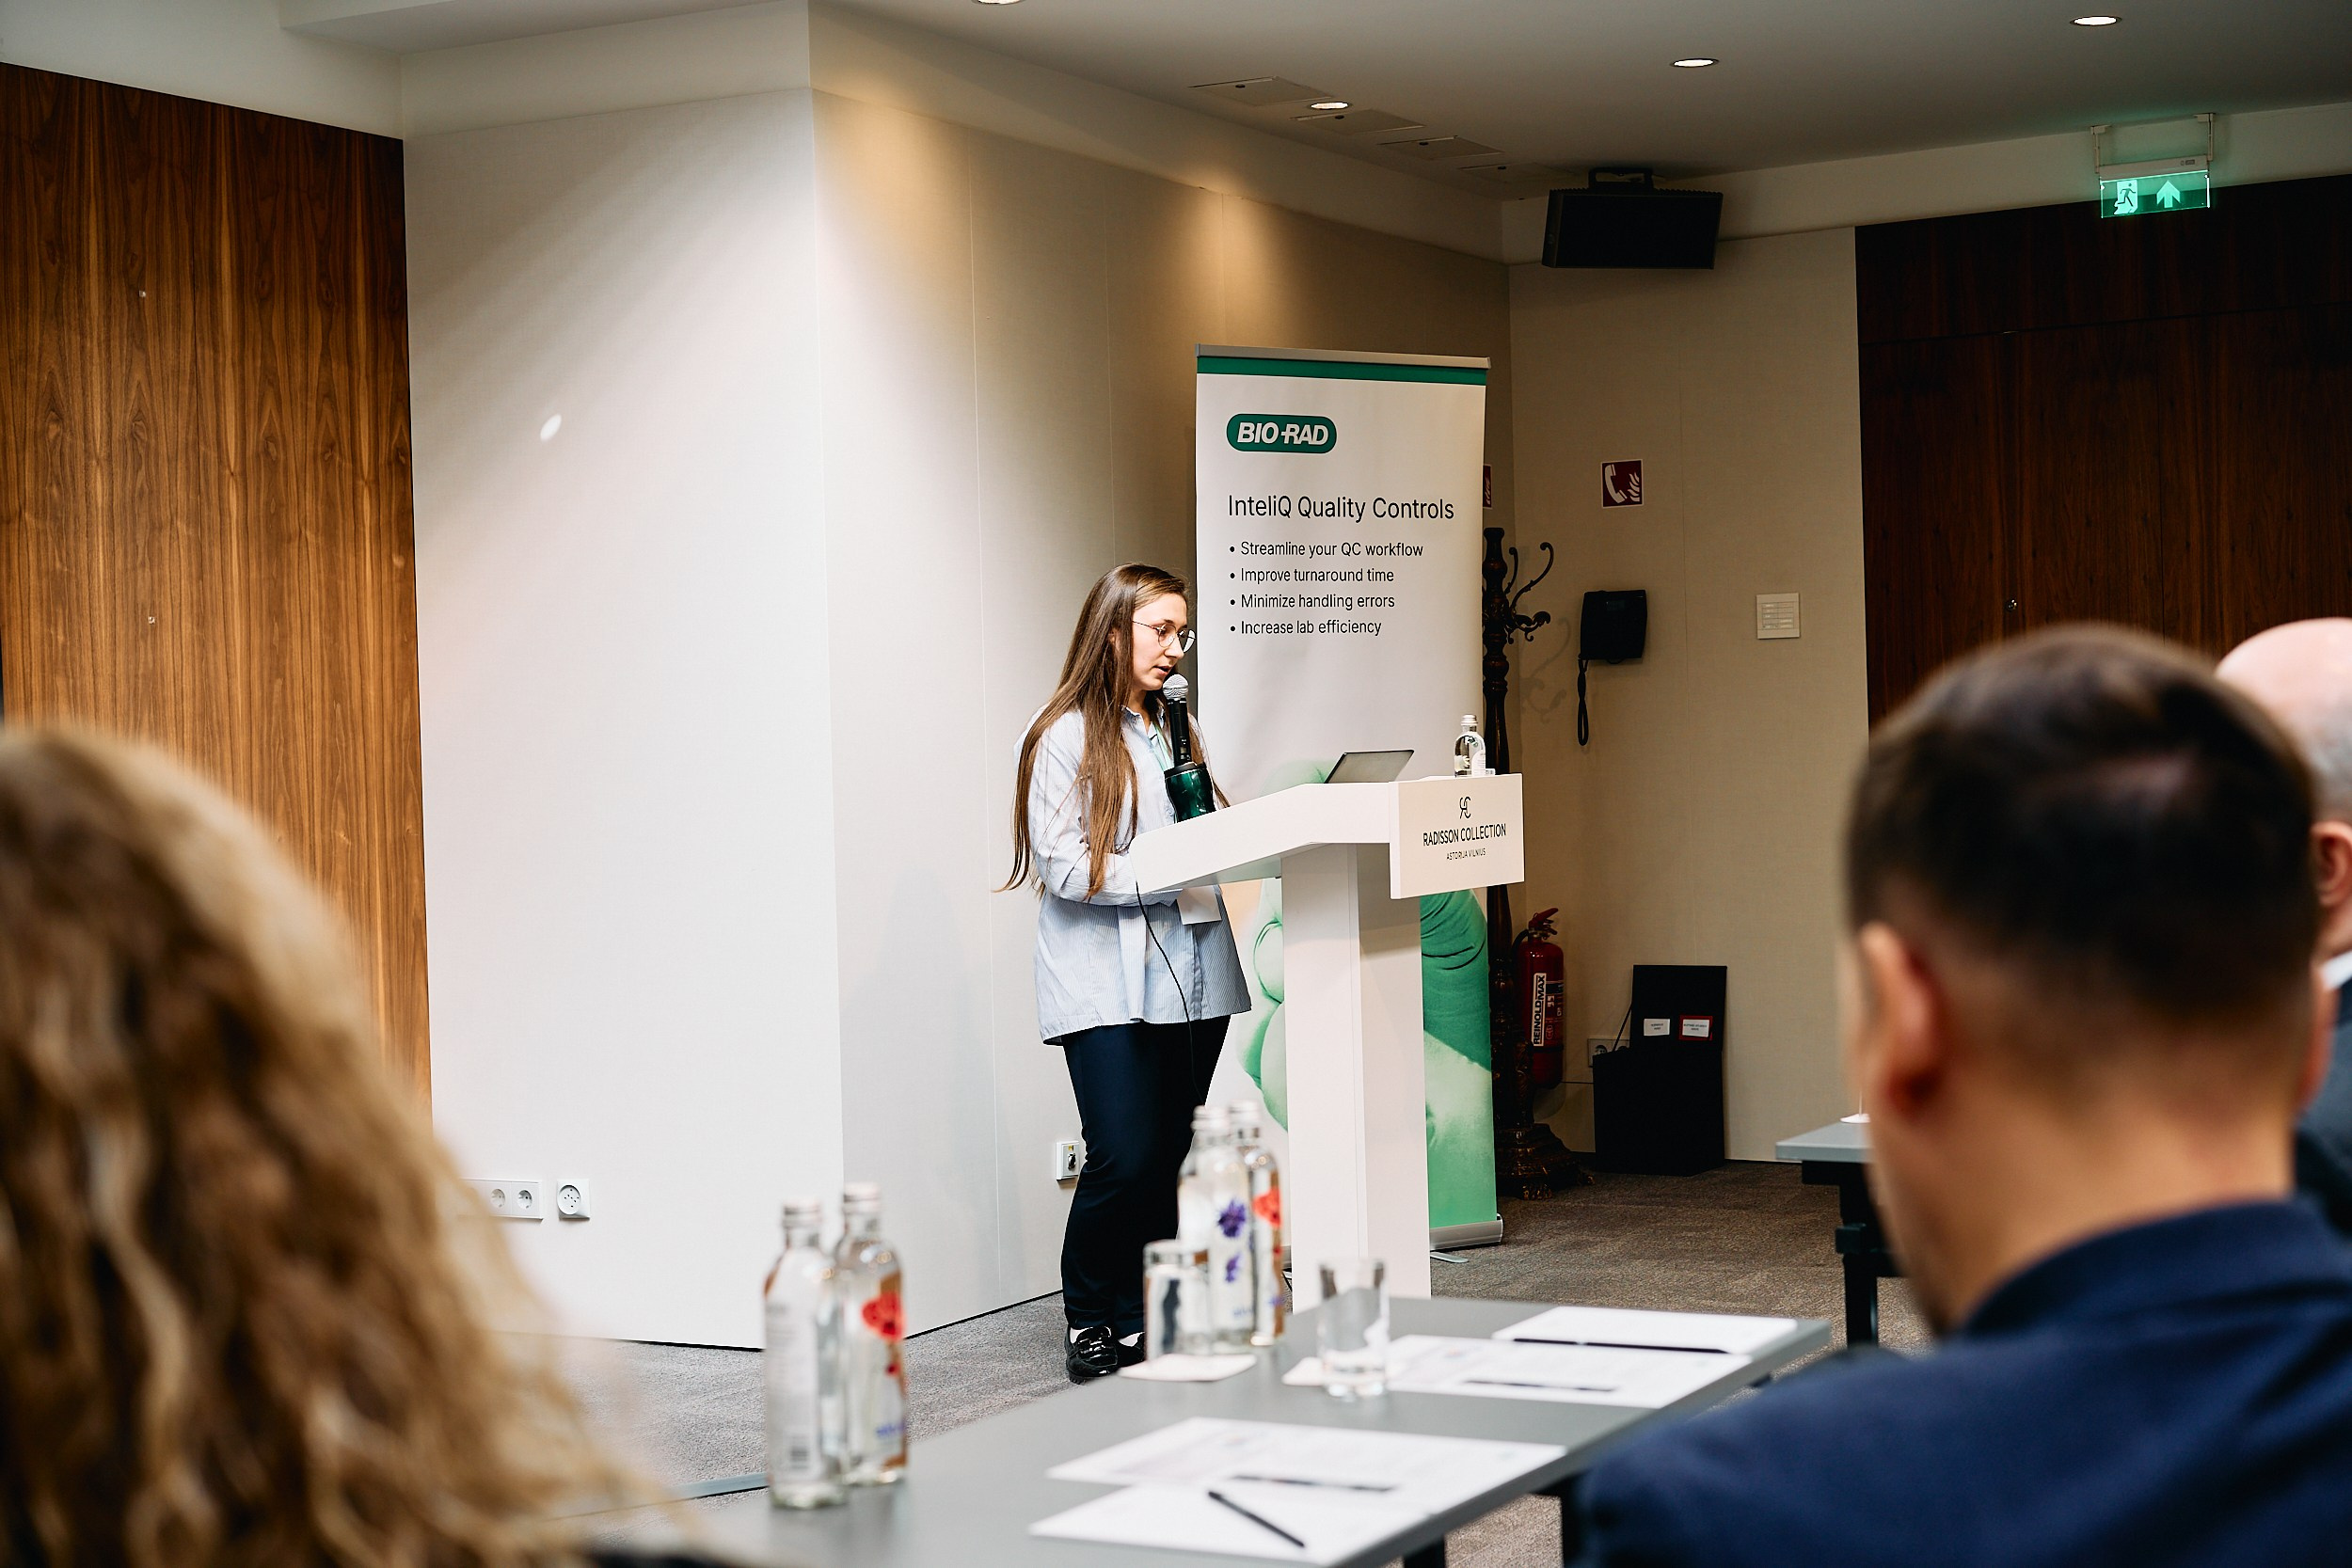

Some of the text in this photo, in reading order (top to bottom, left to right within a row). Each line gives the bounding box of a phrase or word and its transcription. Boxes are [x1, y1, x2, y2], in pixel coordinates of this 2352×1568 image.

[1236, 421, 1329, 446] BIO-RAD
[1230, 495, 1454, 523] InteliQ Quality Controls
[1241, 542, 1422, 559] Streamline your QC workflow
[1242, 568, 1393, 584] Improve turnaround time
[1242, 594, 1394, 610] Minimize handling errors
[1242, 620, 1381, 636] Increase lab efficiency
[1423, 823, 1506, 846] RADISSON COLLECTION
[1469, 847, 1486, 858] VILNIUS
